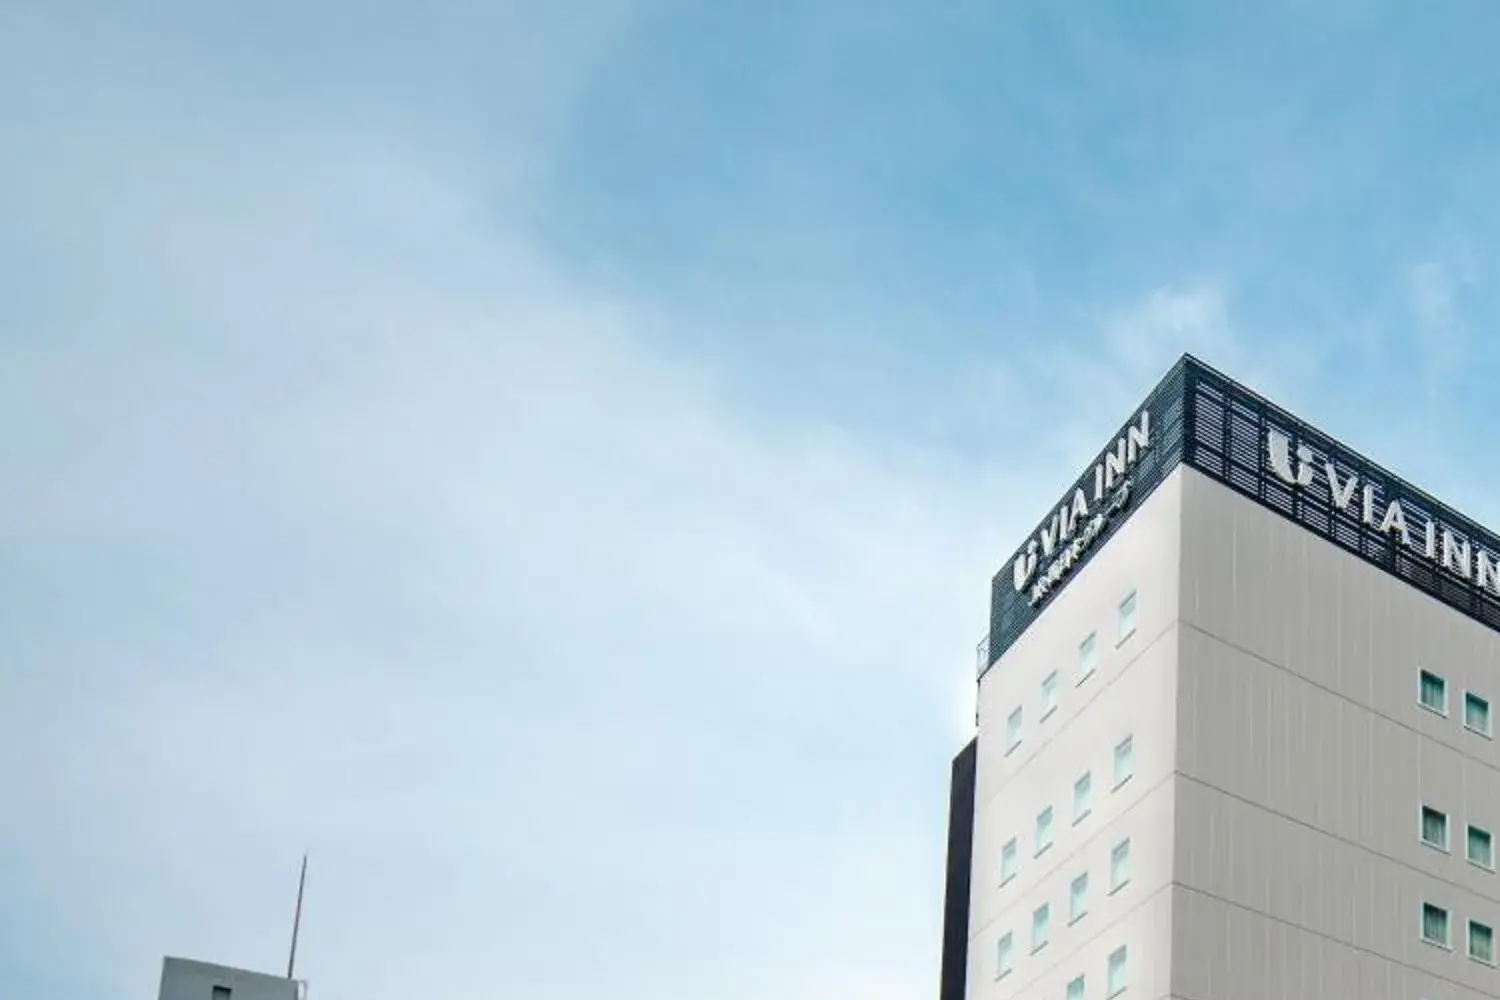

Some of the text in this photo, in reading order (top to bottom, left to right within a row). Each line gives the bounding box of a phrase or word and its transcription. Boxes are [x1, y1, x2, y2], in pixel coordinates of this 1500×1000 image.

[1041, 410, 1149, 556] VIA INN
[1324, 463, 1411, 545] VIA
